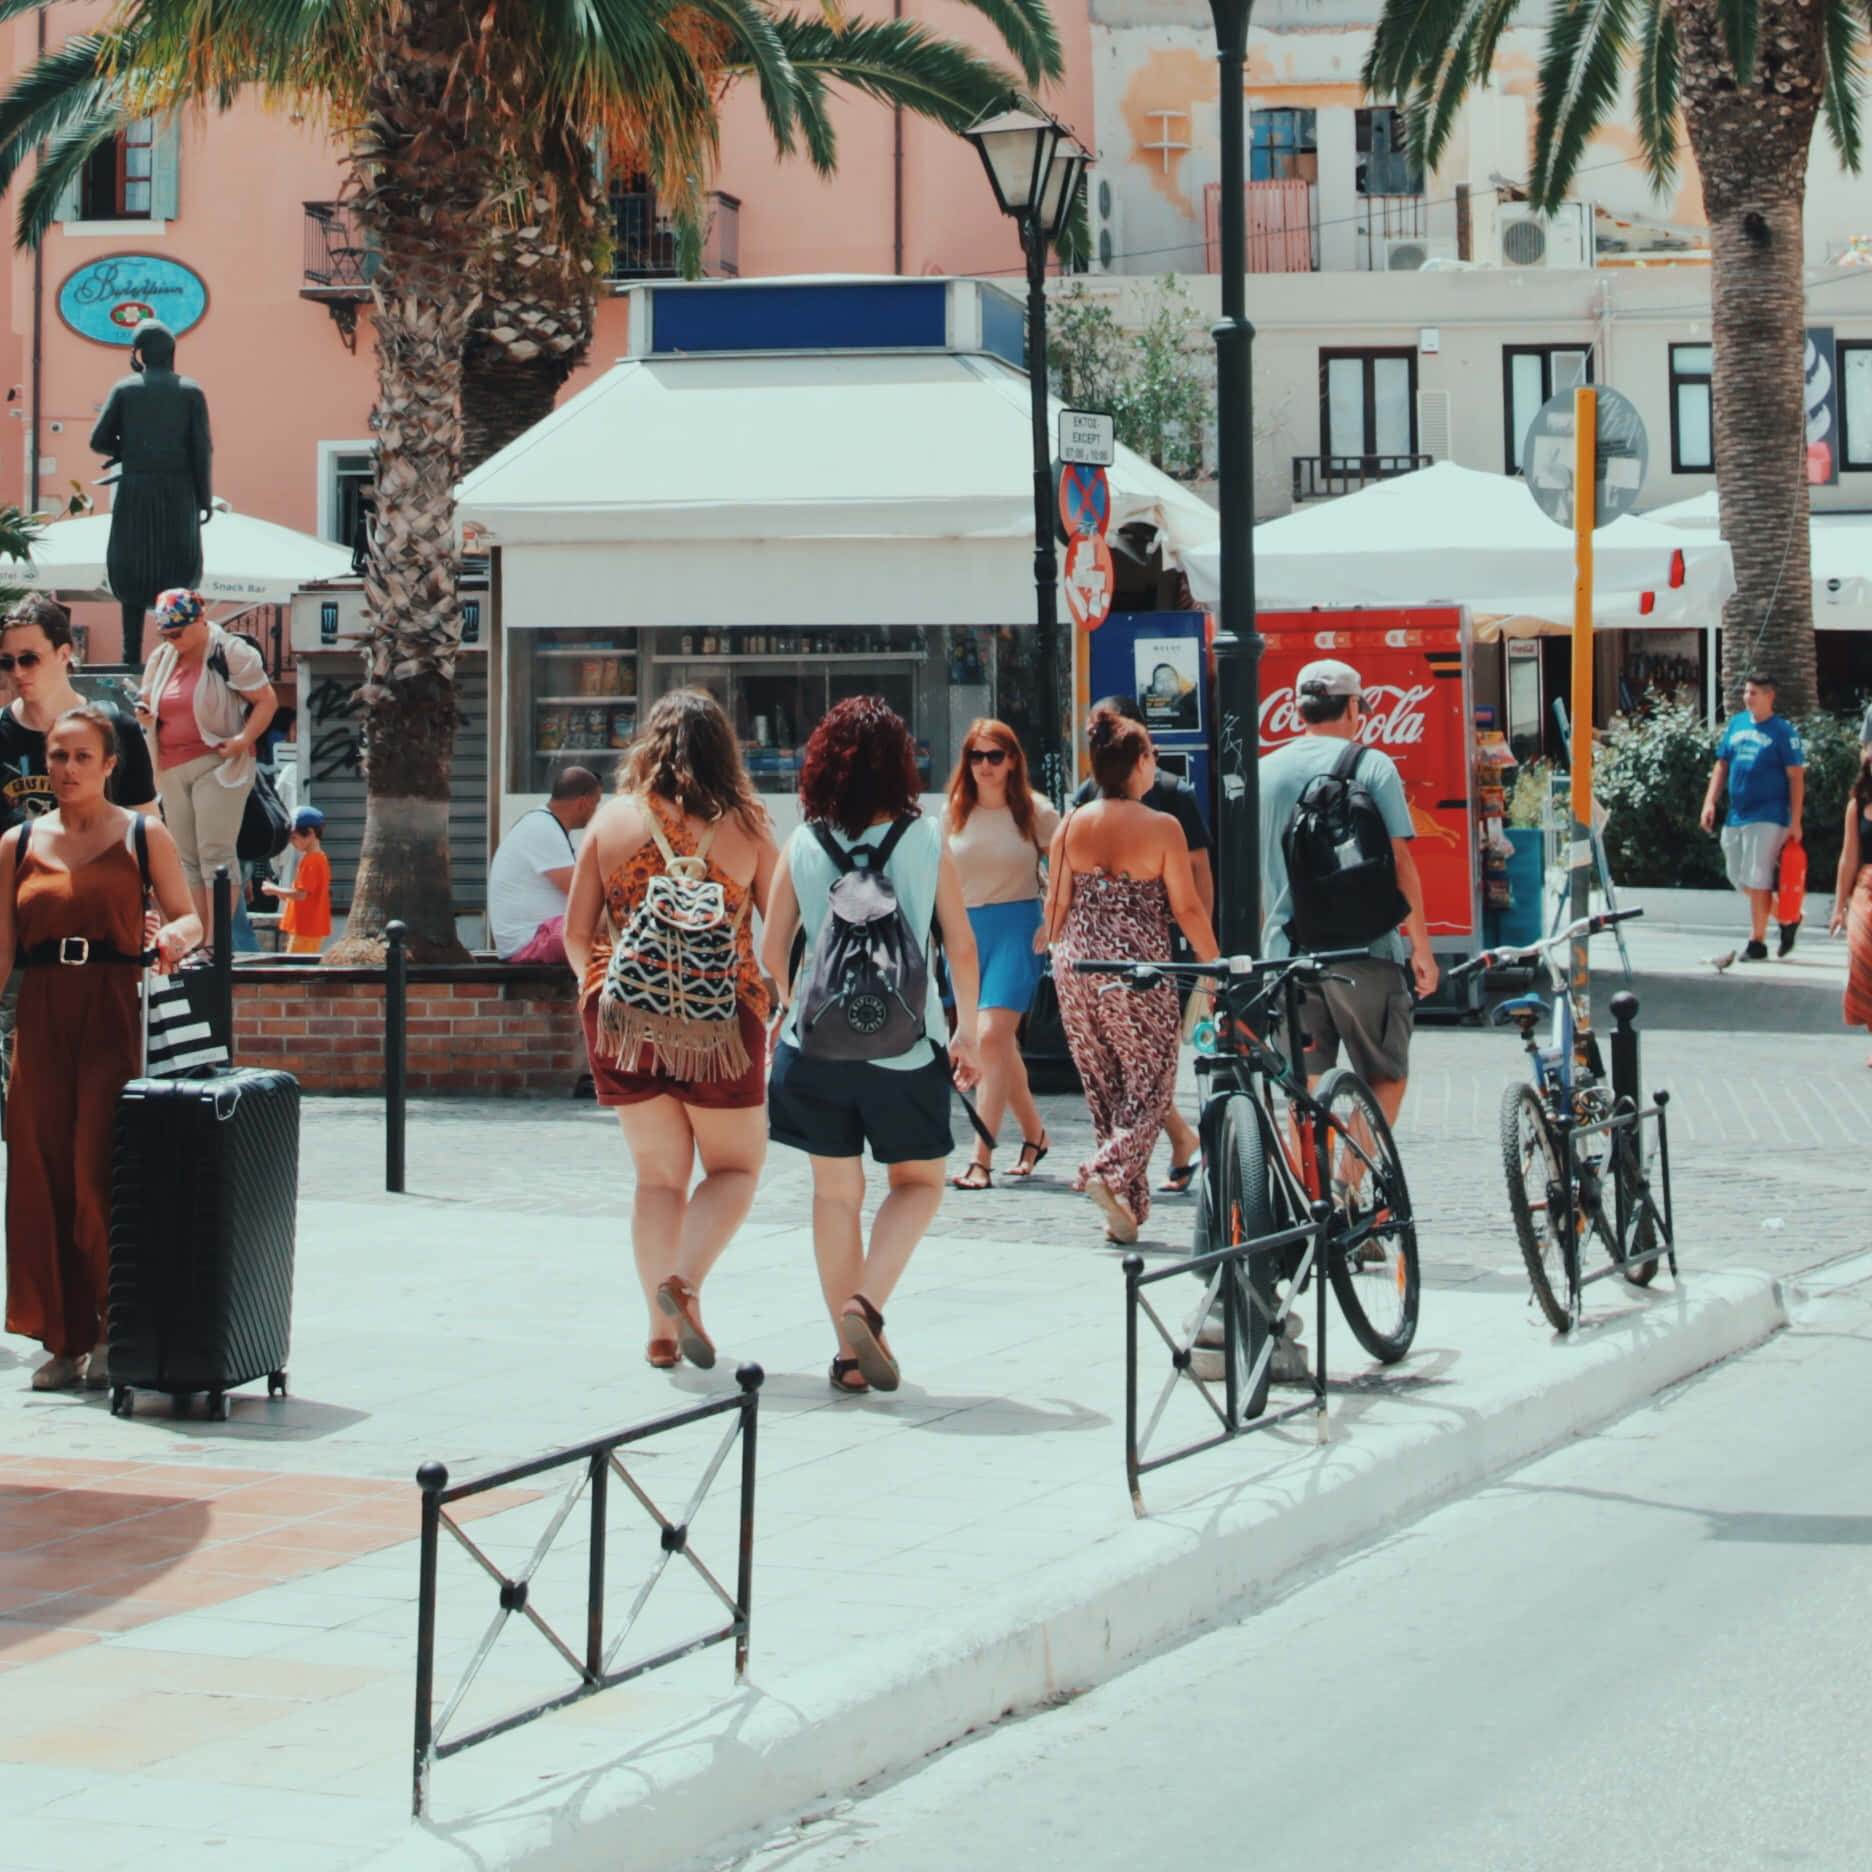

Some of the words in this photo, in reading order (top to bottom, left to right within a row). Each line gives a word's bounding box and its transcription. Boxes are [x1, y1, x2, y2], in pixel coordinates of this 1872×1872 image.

[1072, 431, 1101, 445] EXCEPT
[213, 581, 243, 592] Snack
[247, 584, 265, 593] Bar
